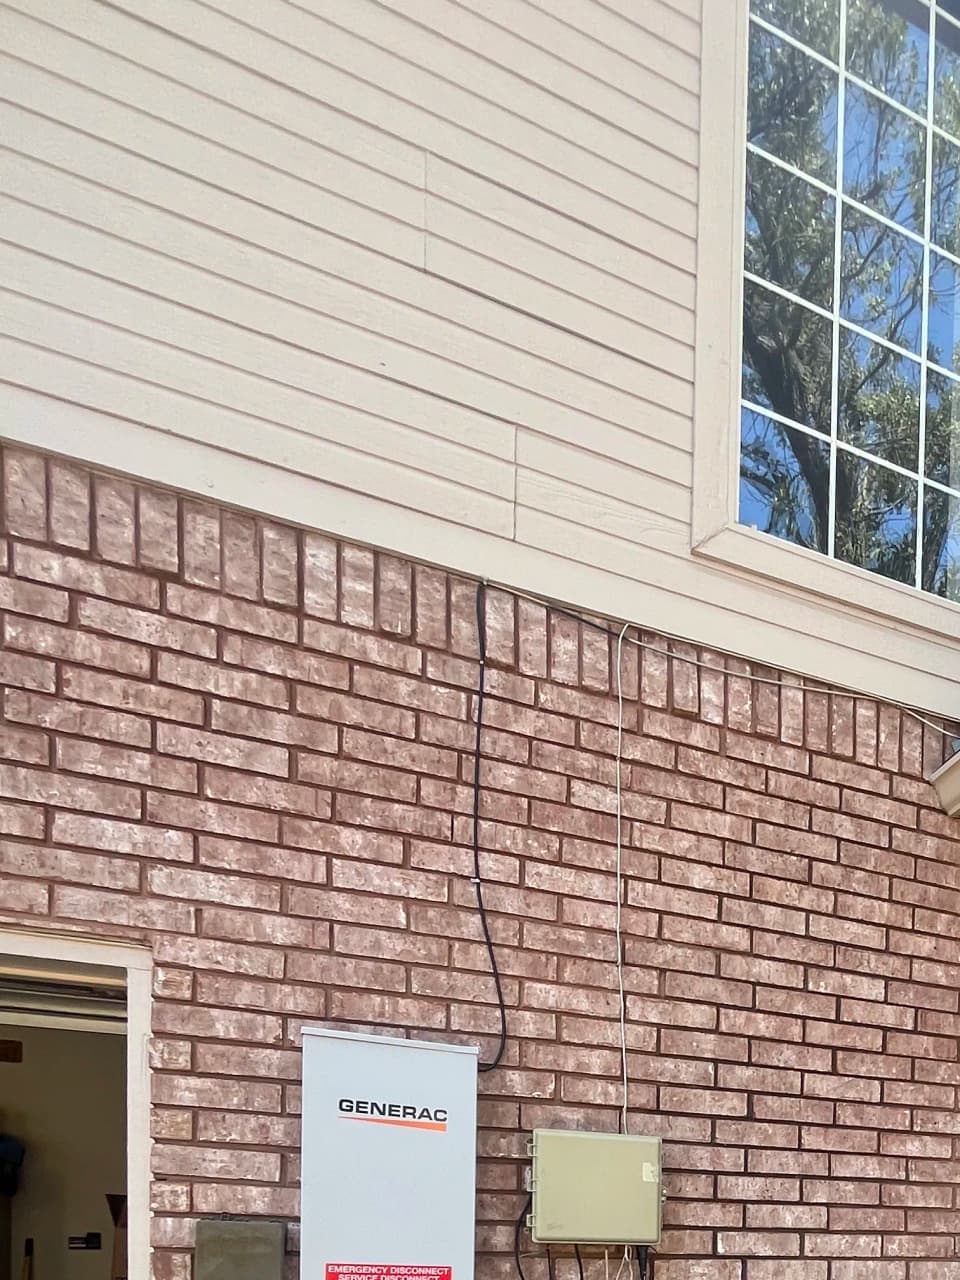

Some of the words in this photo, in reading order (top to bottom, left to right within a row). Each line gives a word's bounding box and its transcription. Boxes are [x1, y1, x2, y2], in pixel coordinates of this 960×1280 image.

[338, 1098, 448, 1122] GENERAC
[328, 1265, 388, 1274] EMERGENCY
[390, 1266, 449, 1275] DISCONNECT
